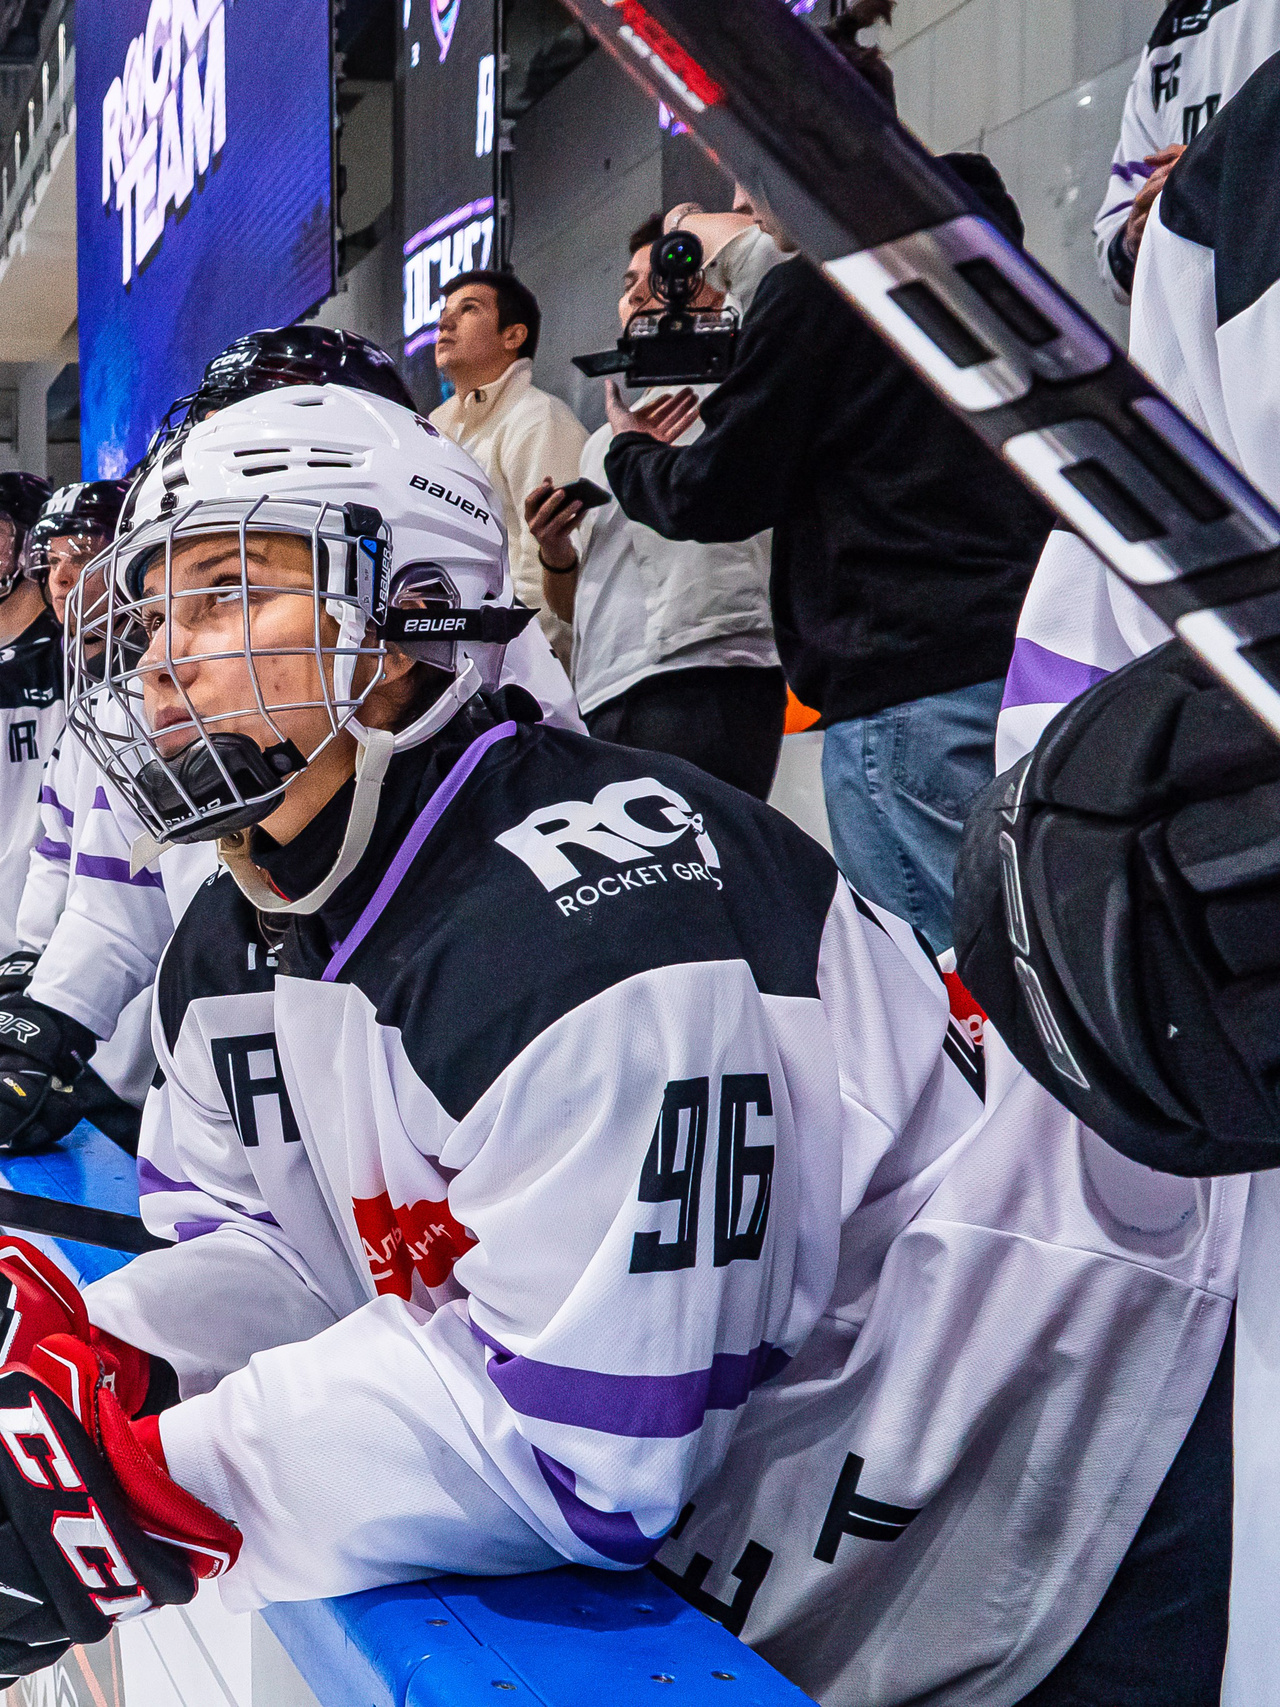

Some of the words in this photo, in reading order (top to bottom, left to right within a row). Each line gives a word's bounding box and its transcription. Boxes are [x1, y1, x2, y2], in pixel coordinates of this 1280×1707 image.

[116, 3, 226, 286] TEAM
[211, 351, 250, 370] CCM
[409, 475, 490, 526] BAUER
[404, 617, 467, 633] BAUER
[555, 863, 666, 917] ROCKET
[628, 1072, 775, 1274] 96
